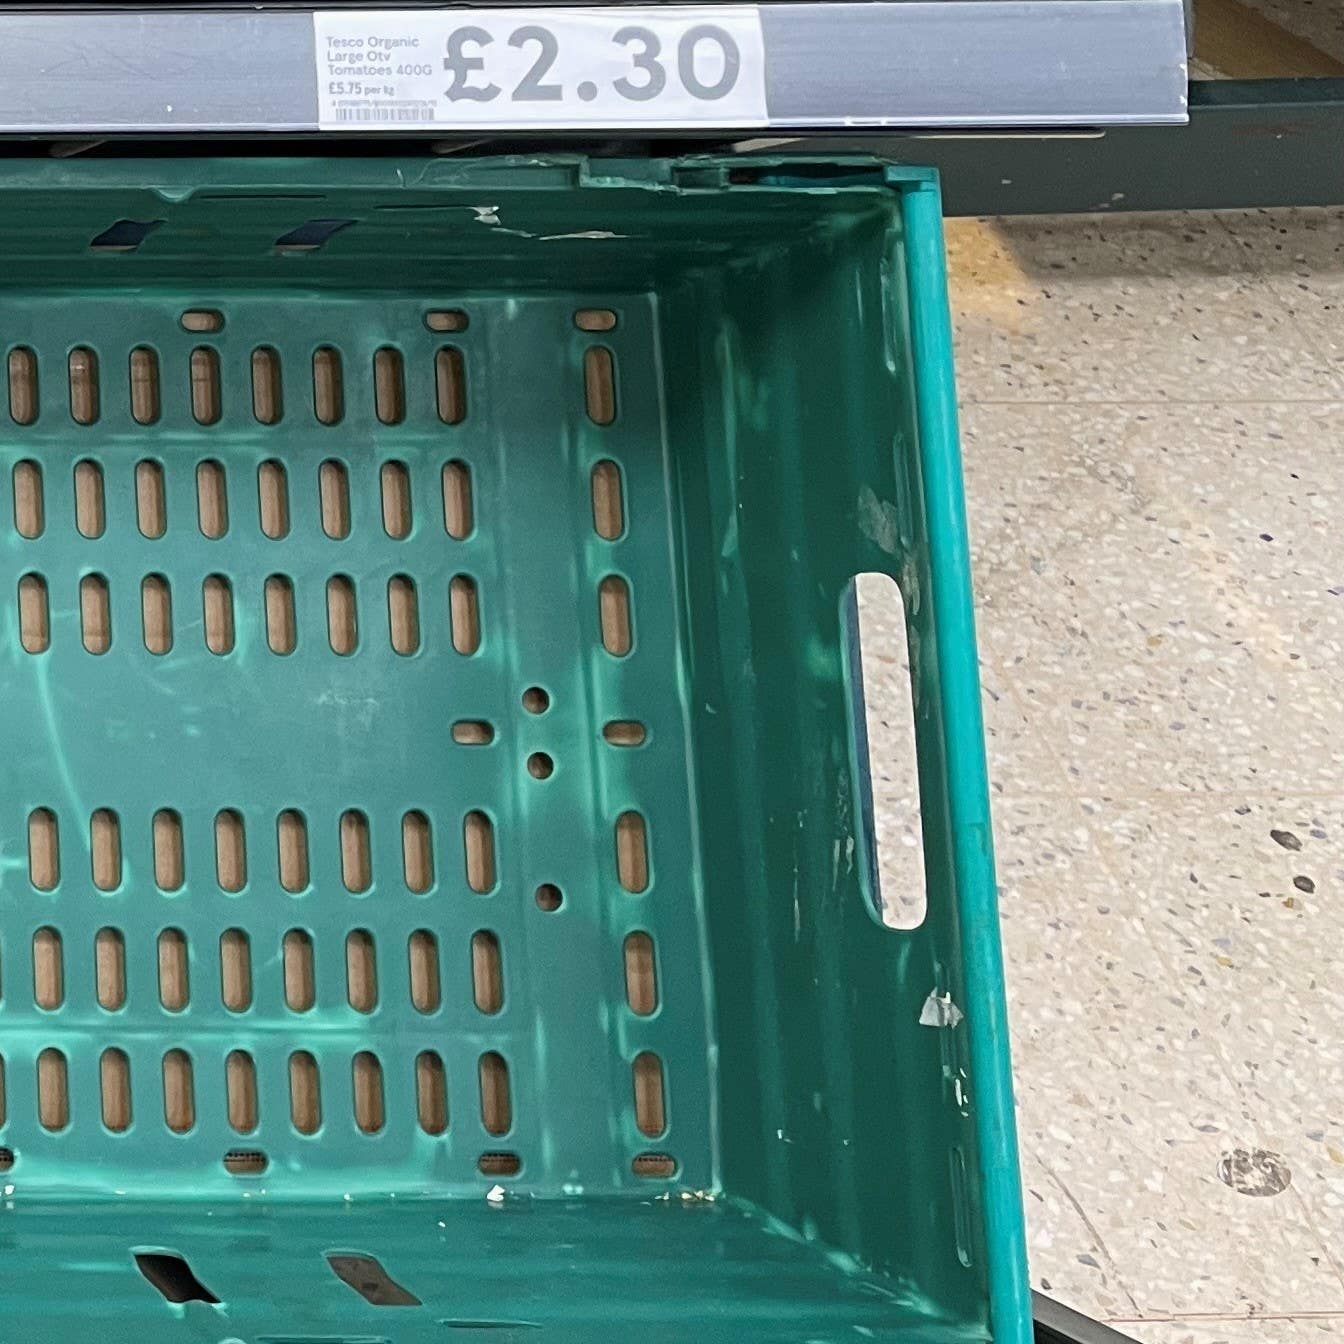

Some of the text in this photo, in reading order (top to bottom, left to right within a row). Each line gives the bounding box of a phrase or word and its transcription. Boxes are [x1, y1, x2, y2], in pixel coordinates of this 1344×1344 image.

[325, 36, 420, 50] Tesco Organic
[327, 50, 364, 64] Large
[442, 24, 741, 104] £2.30
[327, 64, 433, 76] Tomatoes 400G
[328, 81, 363, 94] £5.75
[364, 86, 382, 97] per
